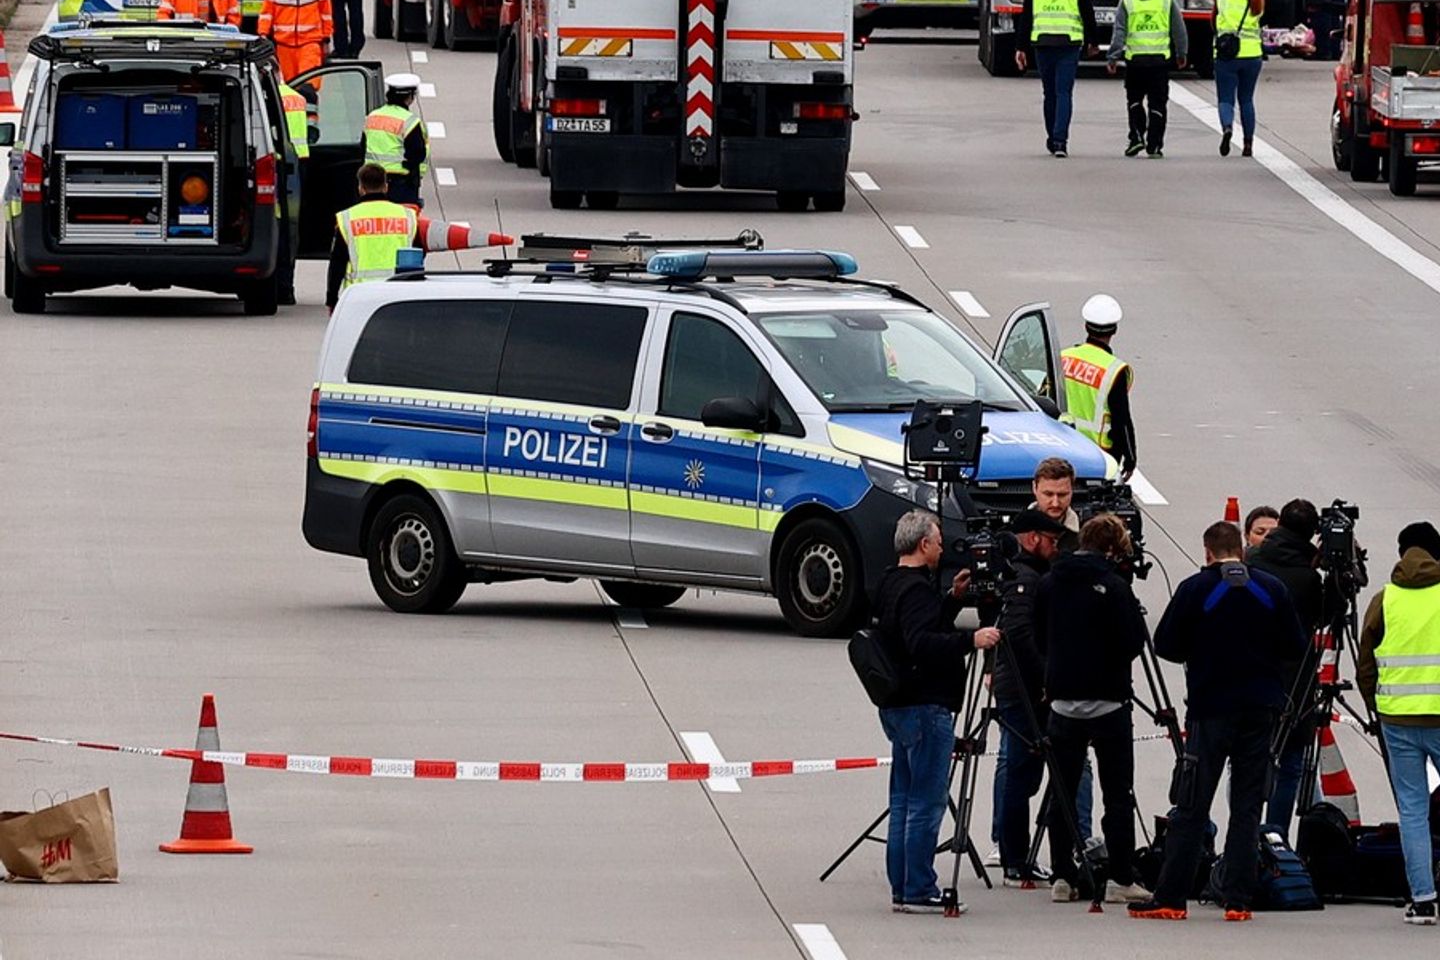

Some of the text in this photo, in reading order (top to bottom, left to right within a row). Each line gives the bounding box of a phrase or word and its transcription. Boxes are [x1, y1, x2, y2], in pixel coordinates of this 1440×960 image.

[1043, 4, 1066, 12] DEKRA
[1136, 24, 1160, 32] DEKRA
[354, 218, 408, 234] POLIZEI
[1061, 357, 1101, 386] OLIZEI
[503, 426, 608, 468] POLIZEI
[982, 431, 1070, 447] LIZEI
[41, 836, 73, 869] H&M
